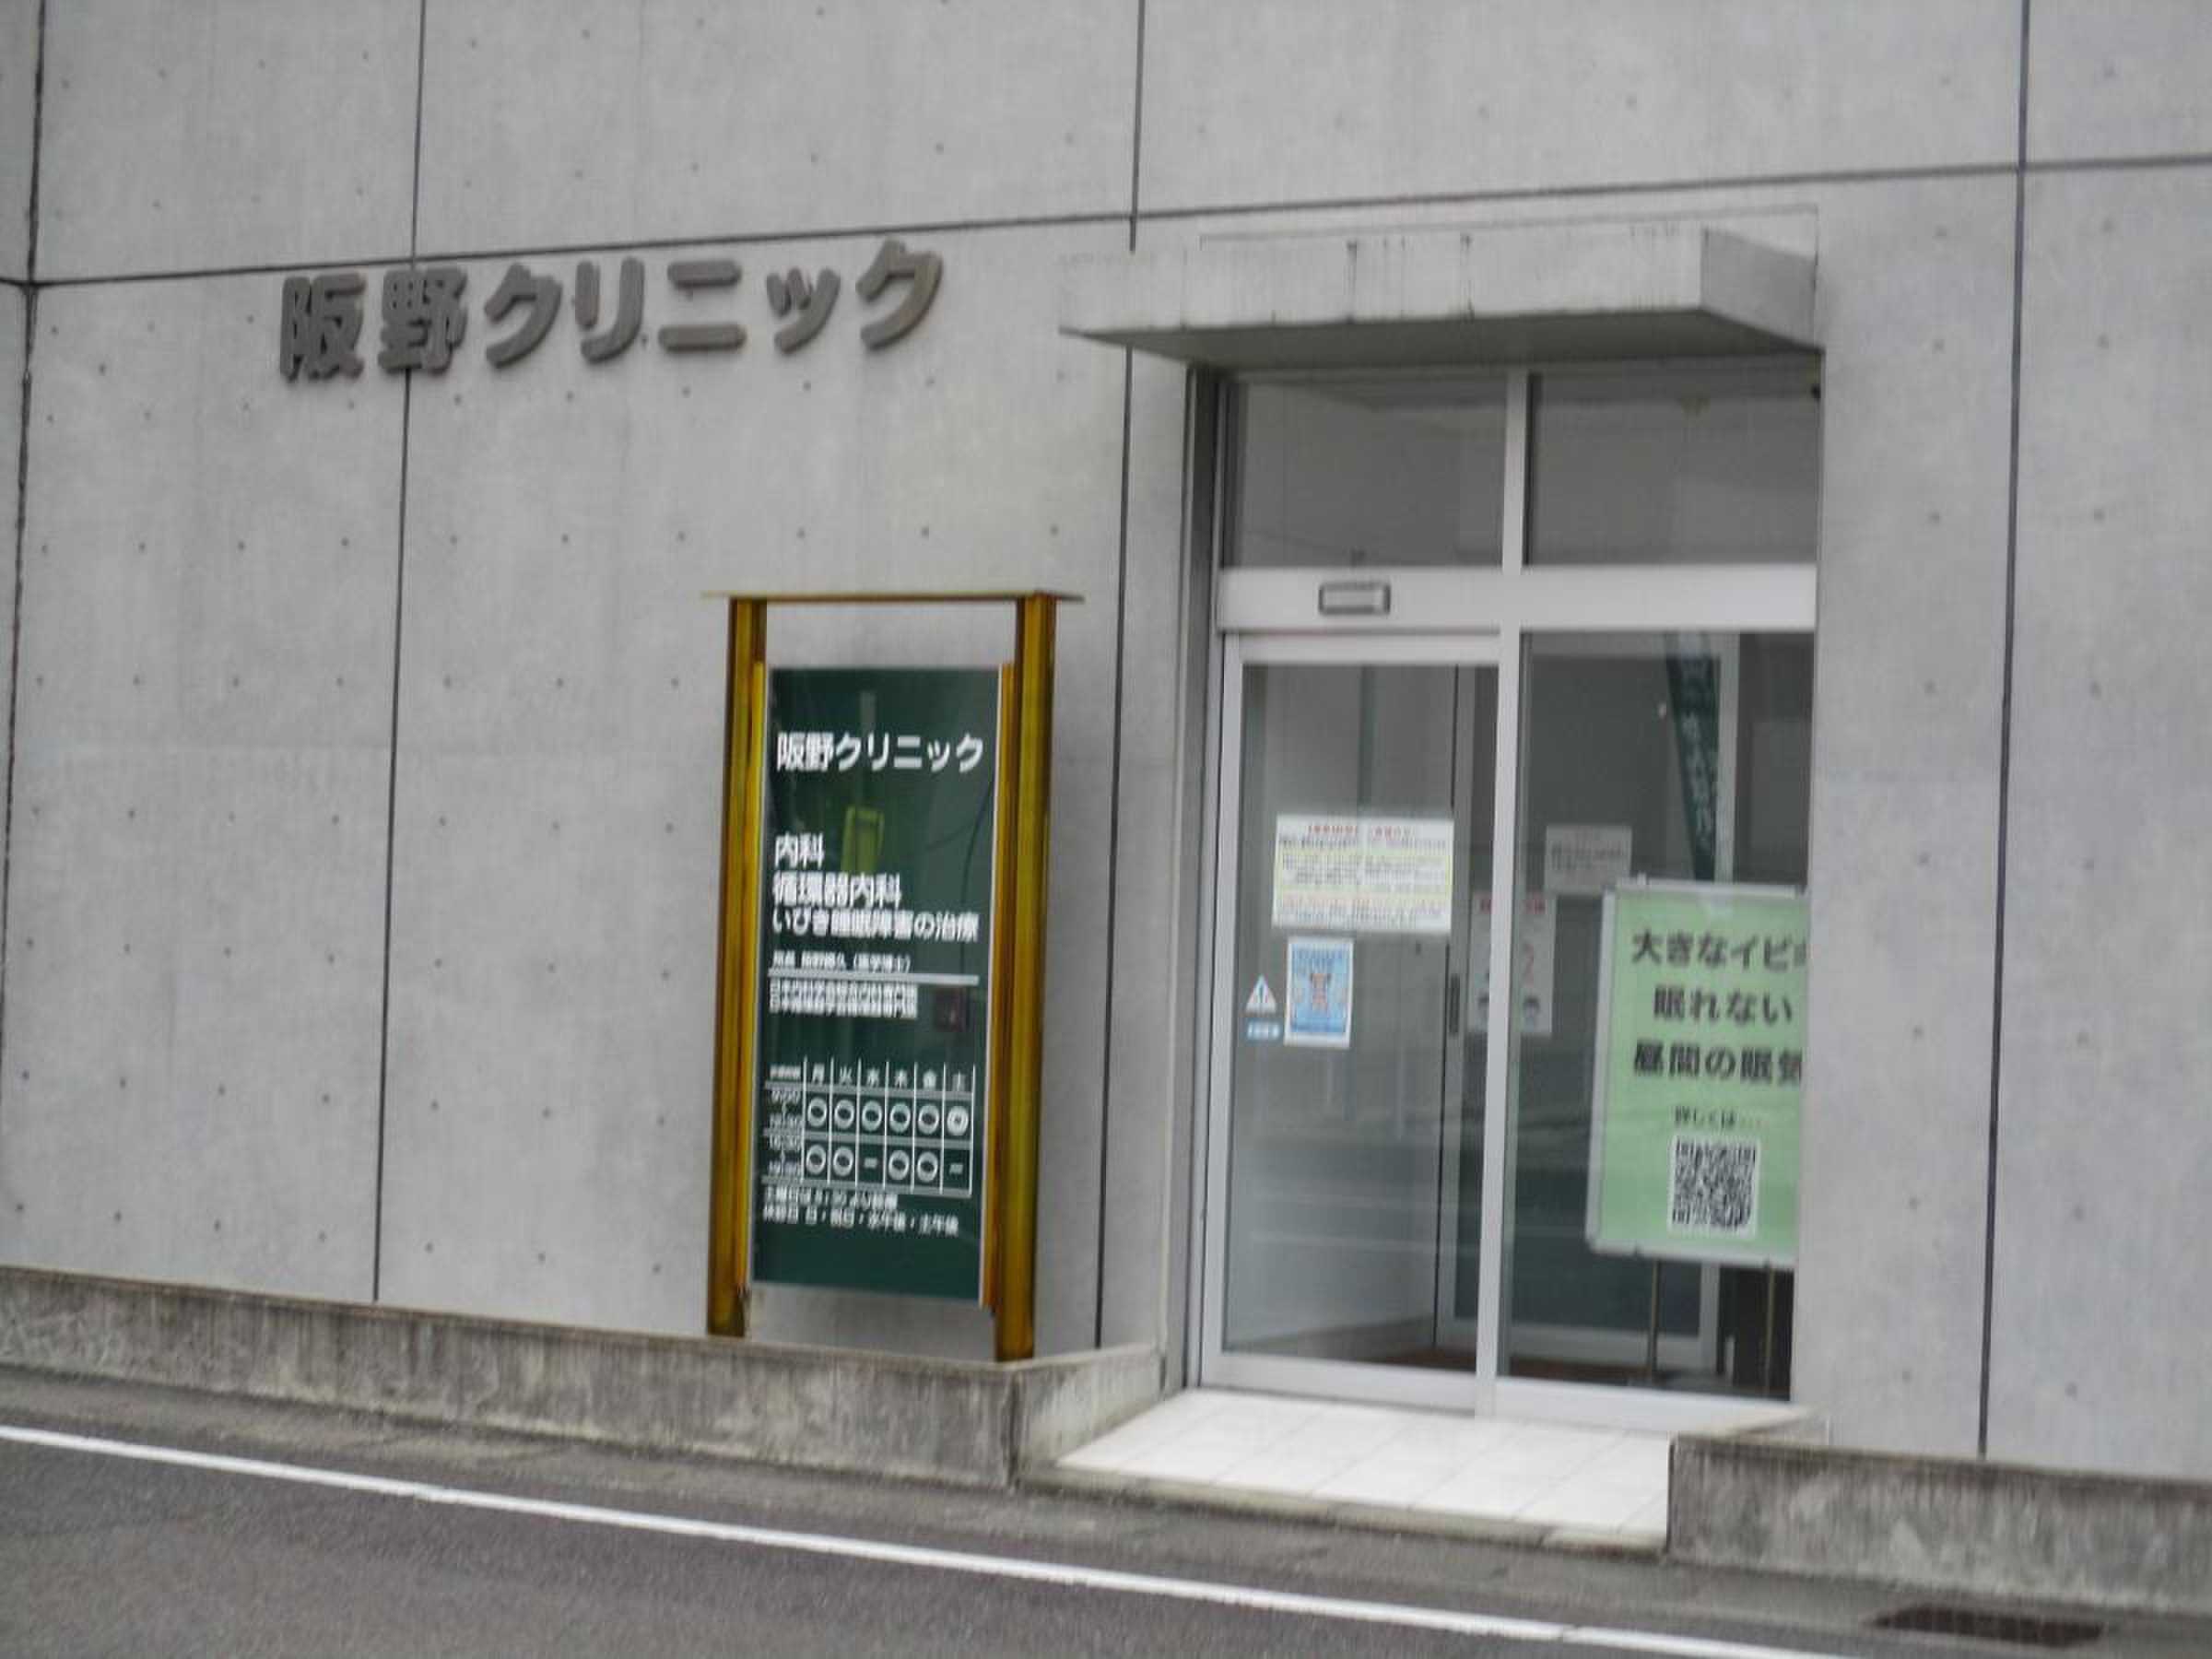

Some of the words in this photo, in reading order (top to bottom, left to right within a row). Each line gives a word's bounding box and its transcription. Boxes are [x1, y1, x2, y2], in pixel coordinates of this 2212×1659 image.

[279, 239, 943, 380] 阪野クリニック
[776, 732, 983, 772] 阪野クリニック
[774, 831, 825, 868] 内科
[772, 870, 902, 908] 循環器内科
[1653, 984, 1793, 1027] 眠れない
[812, 1064, 825, 1085] 月
[840, 1065, 853, 1086] 火
